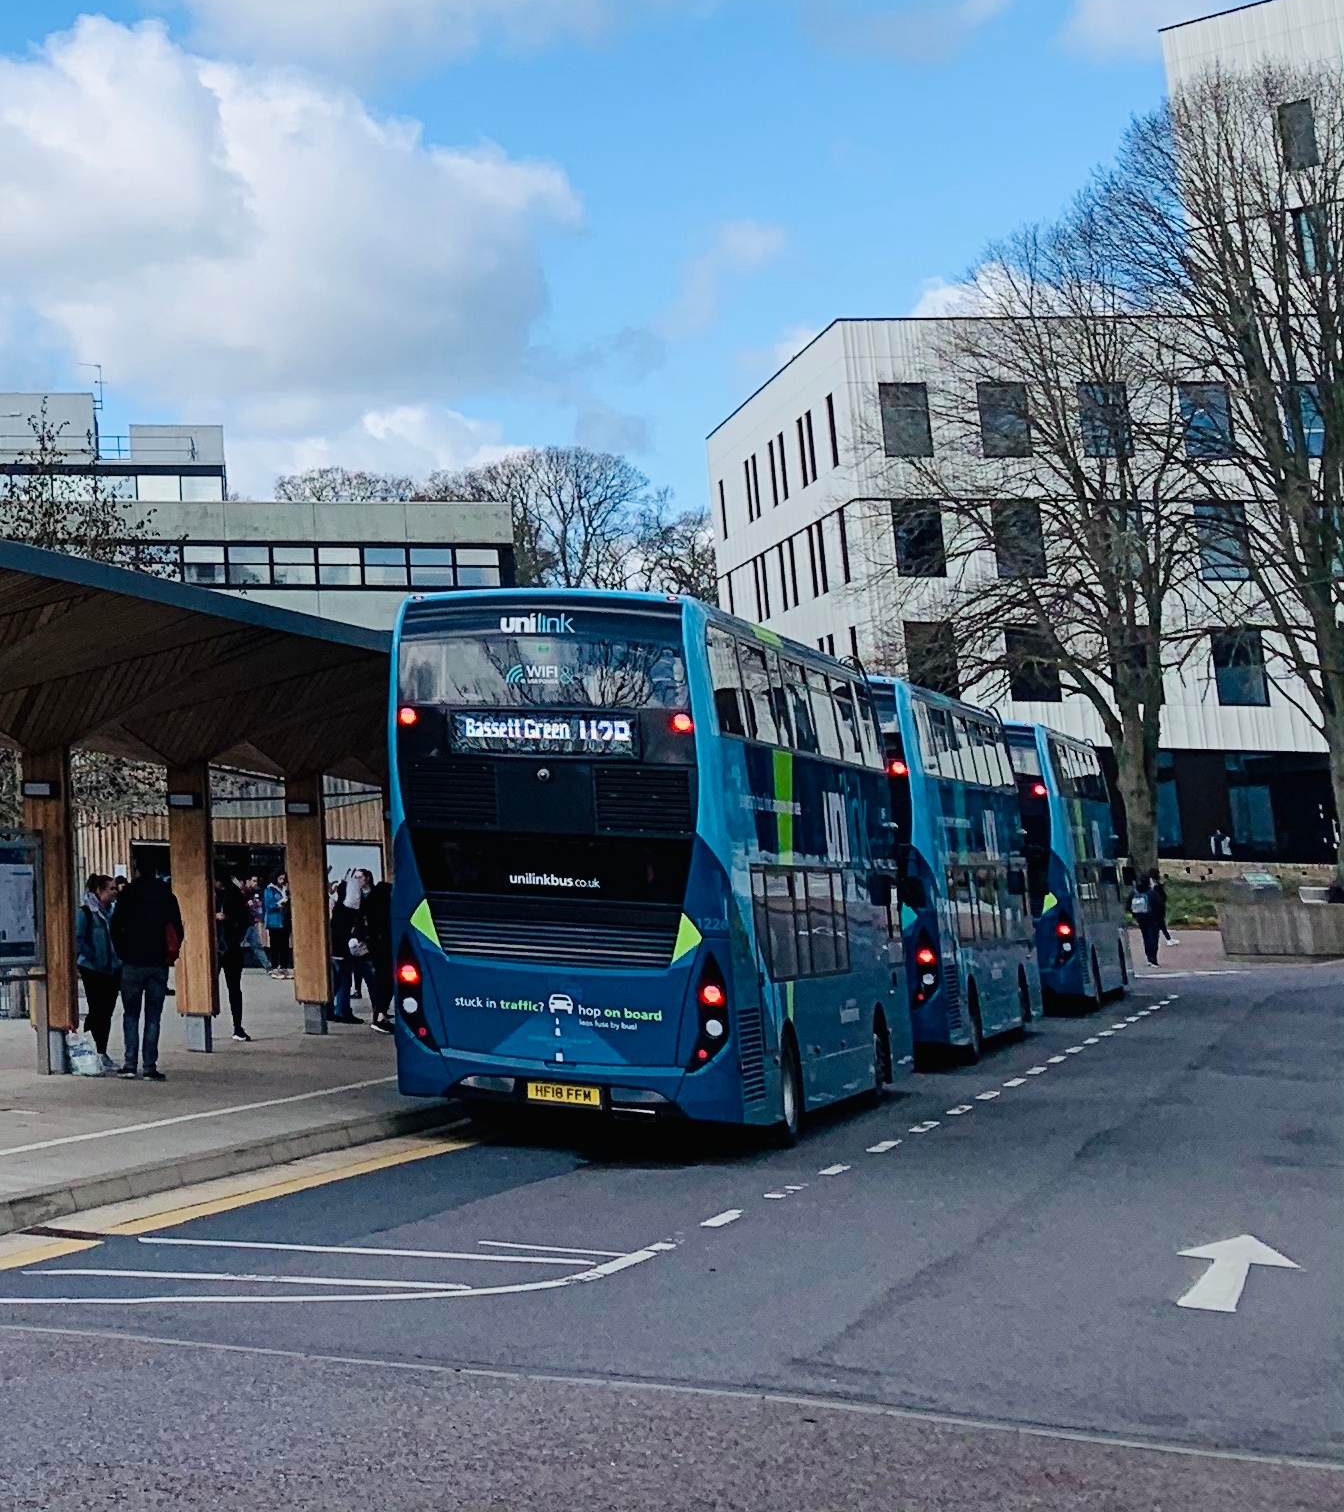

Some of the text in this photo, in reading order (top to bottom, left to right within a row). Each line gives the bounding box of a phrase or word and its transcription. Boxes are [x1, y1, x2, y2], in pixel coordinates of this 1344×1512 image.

[500, 612, 576, 634] unilink
[525, 665, 558, 678] WIFI
[466, 718, 522, 738] Bassett
[524, 719, 570, 739] Green
[509, 872, 601, 889] unilinkbus.co.uk
[454, 996, 545, 1013] stuck in traffic?
[578, 1004, 663, 1022] hop on board
[610, 1020, 621, 1031] by
[535, 1084, 592, 1102] HF18 FFM
